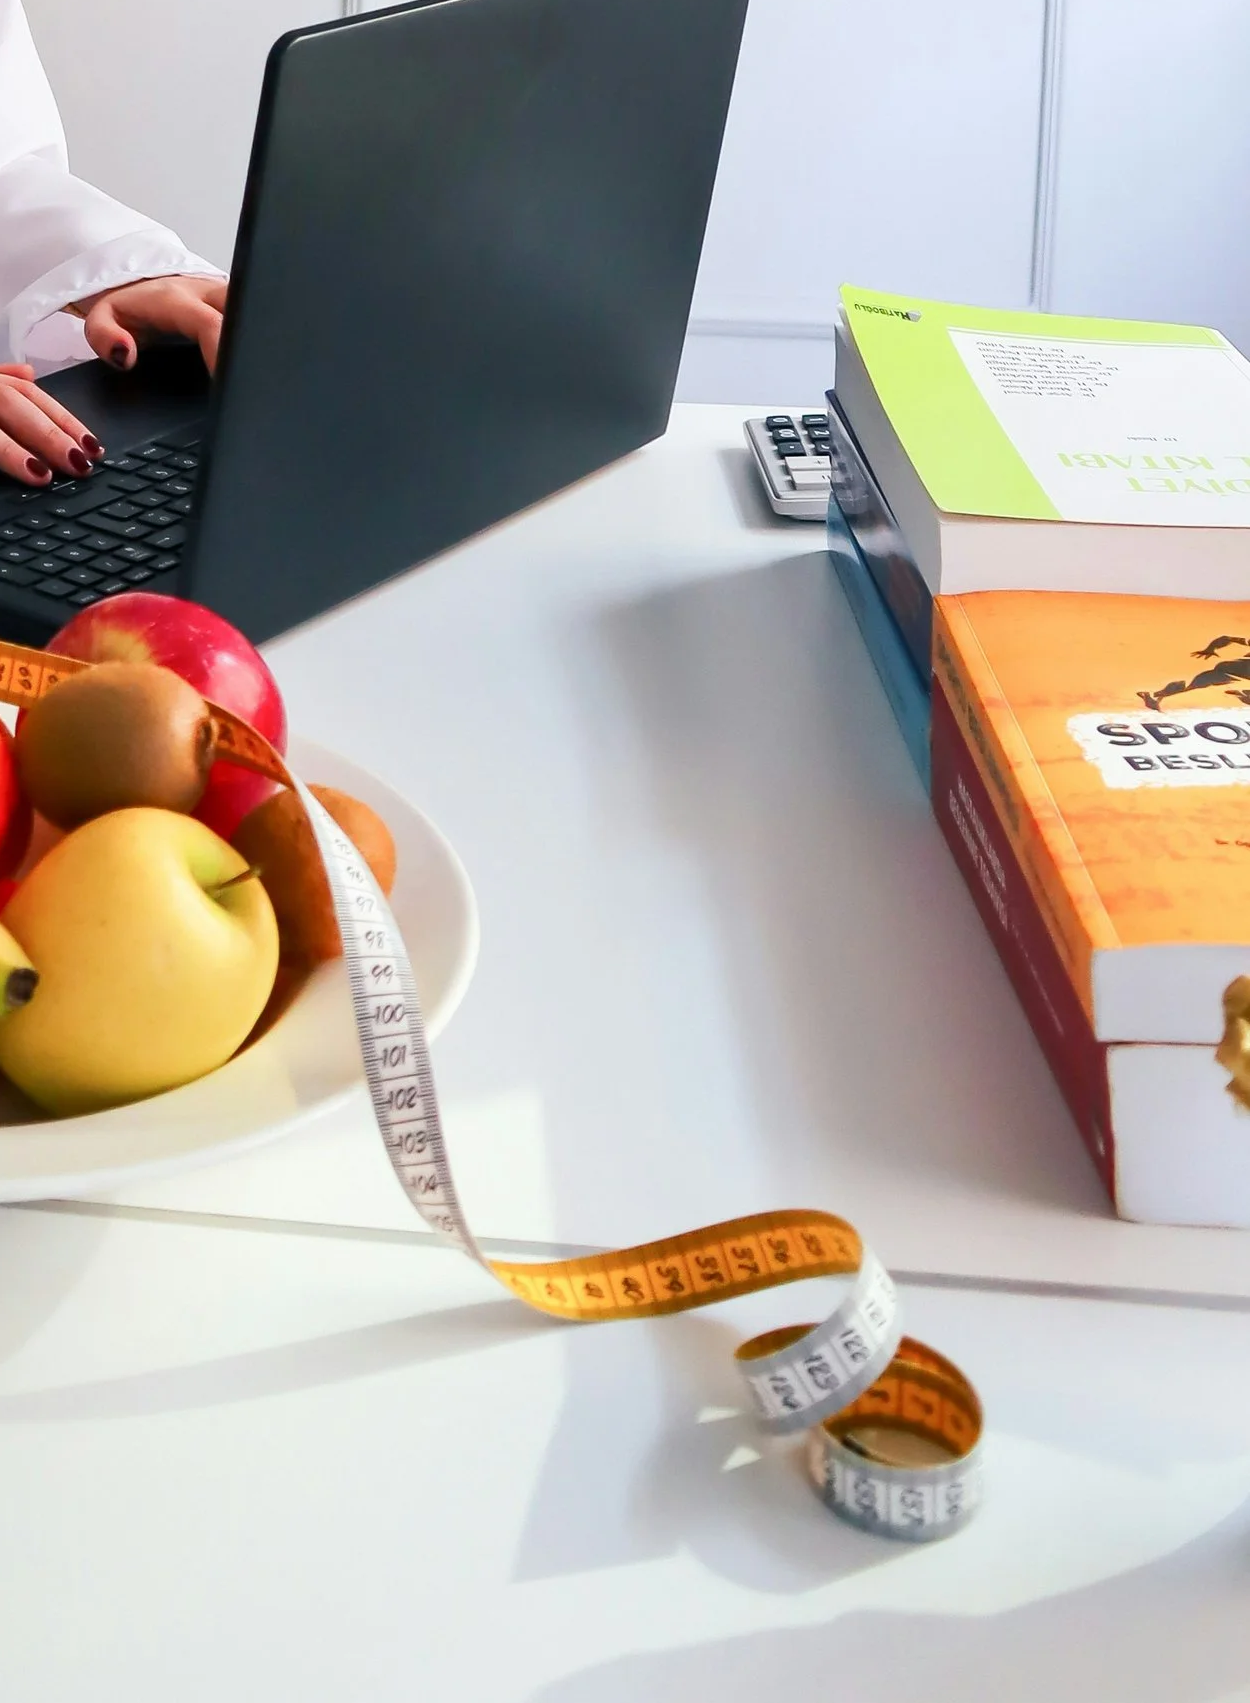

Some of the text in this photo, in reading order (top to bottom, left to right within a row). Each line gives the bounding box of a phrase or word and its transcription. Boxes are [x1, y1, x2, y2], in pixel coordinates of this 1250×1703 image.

[1097, 721, 1250, 746] SPO
[1123, 753, 1250, 771] BESL
[365, 930, 385, 948] 98
[371, 964, 393, 984] 99
[375, 1004, 405, 1023] 100
[382, 1045, 407, 1067] 101
[387, 1087, 418, 1110] 102
[397, 1131, 427, 1153] 103
